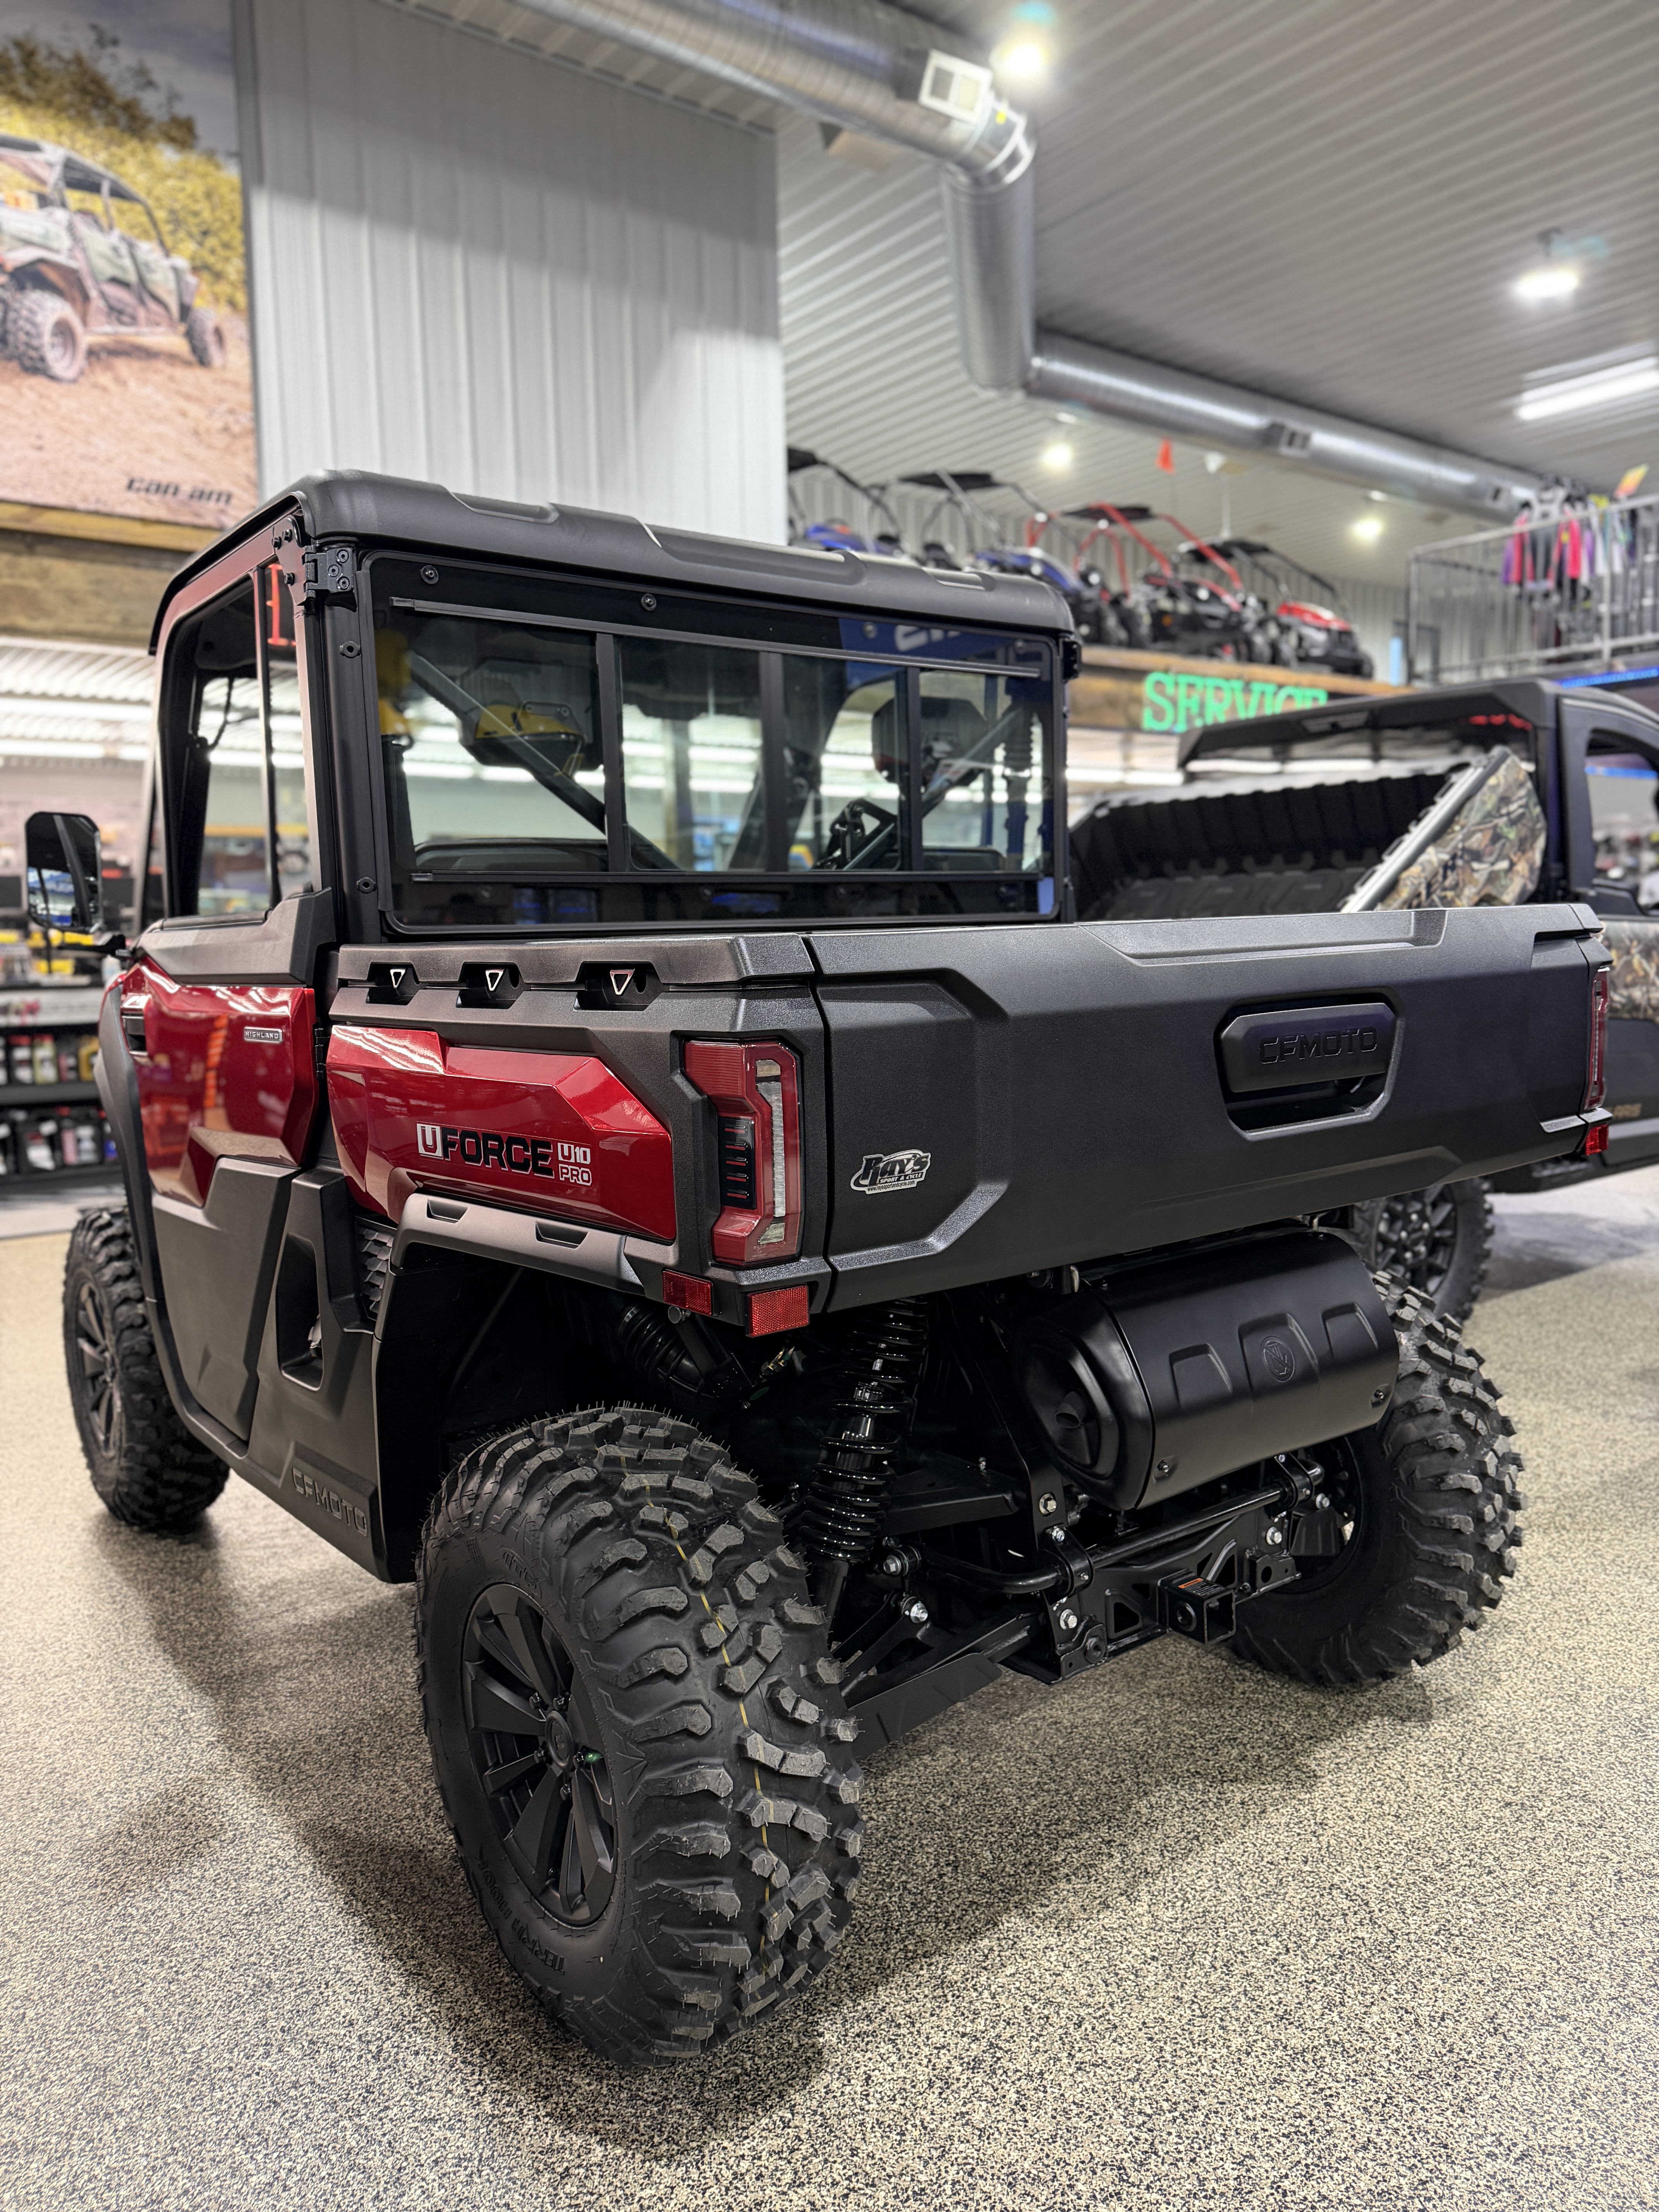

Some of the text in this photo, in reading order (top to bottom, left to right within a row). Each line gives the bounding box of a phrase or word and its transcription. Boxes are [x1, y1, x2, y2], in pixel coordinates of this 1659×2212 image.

[245, 1031, 279, 1039] HIGHLAND
[1259, 1027, 1377, 1064] CFMOTO
[558, 1142, 591, 1165] U10
[558, 1163, 592, 1186] PRO
[858, 1154, 929, 1187] Ray's
[292, 1467, 368, 1537] CFMOTO
